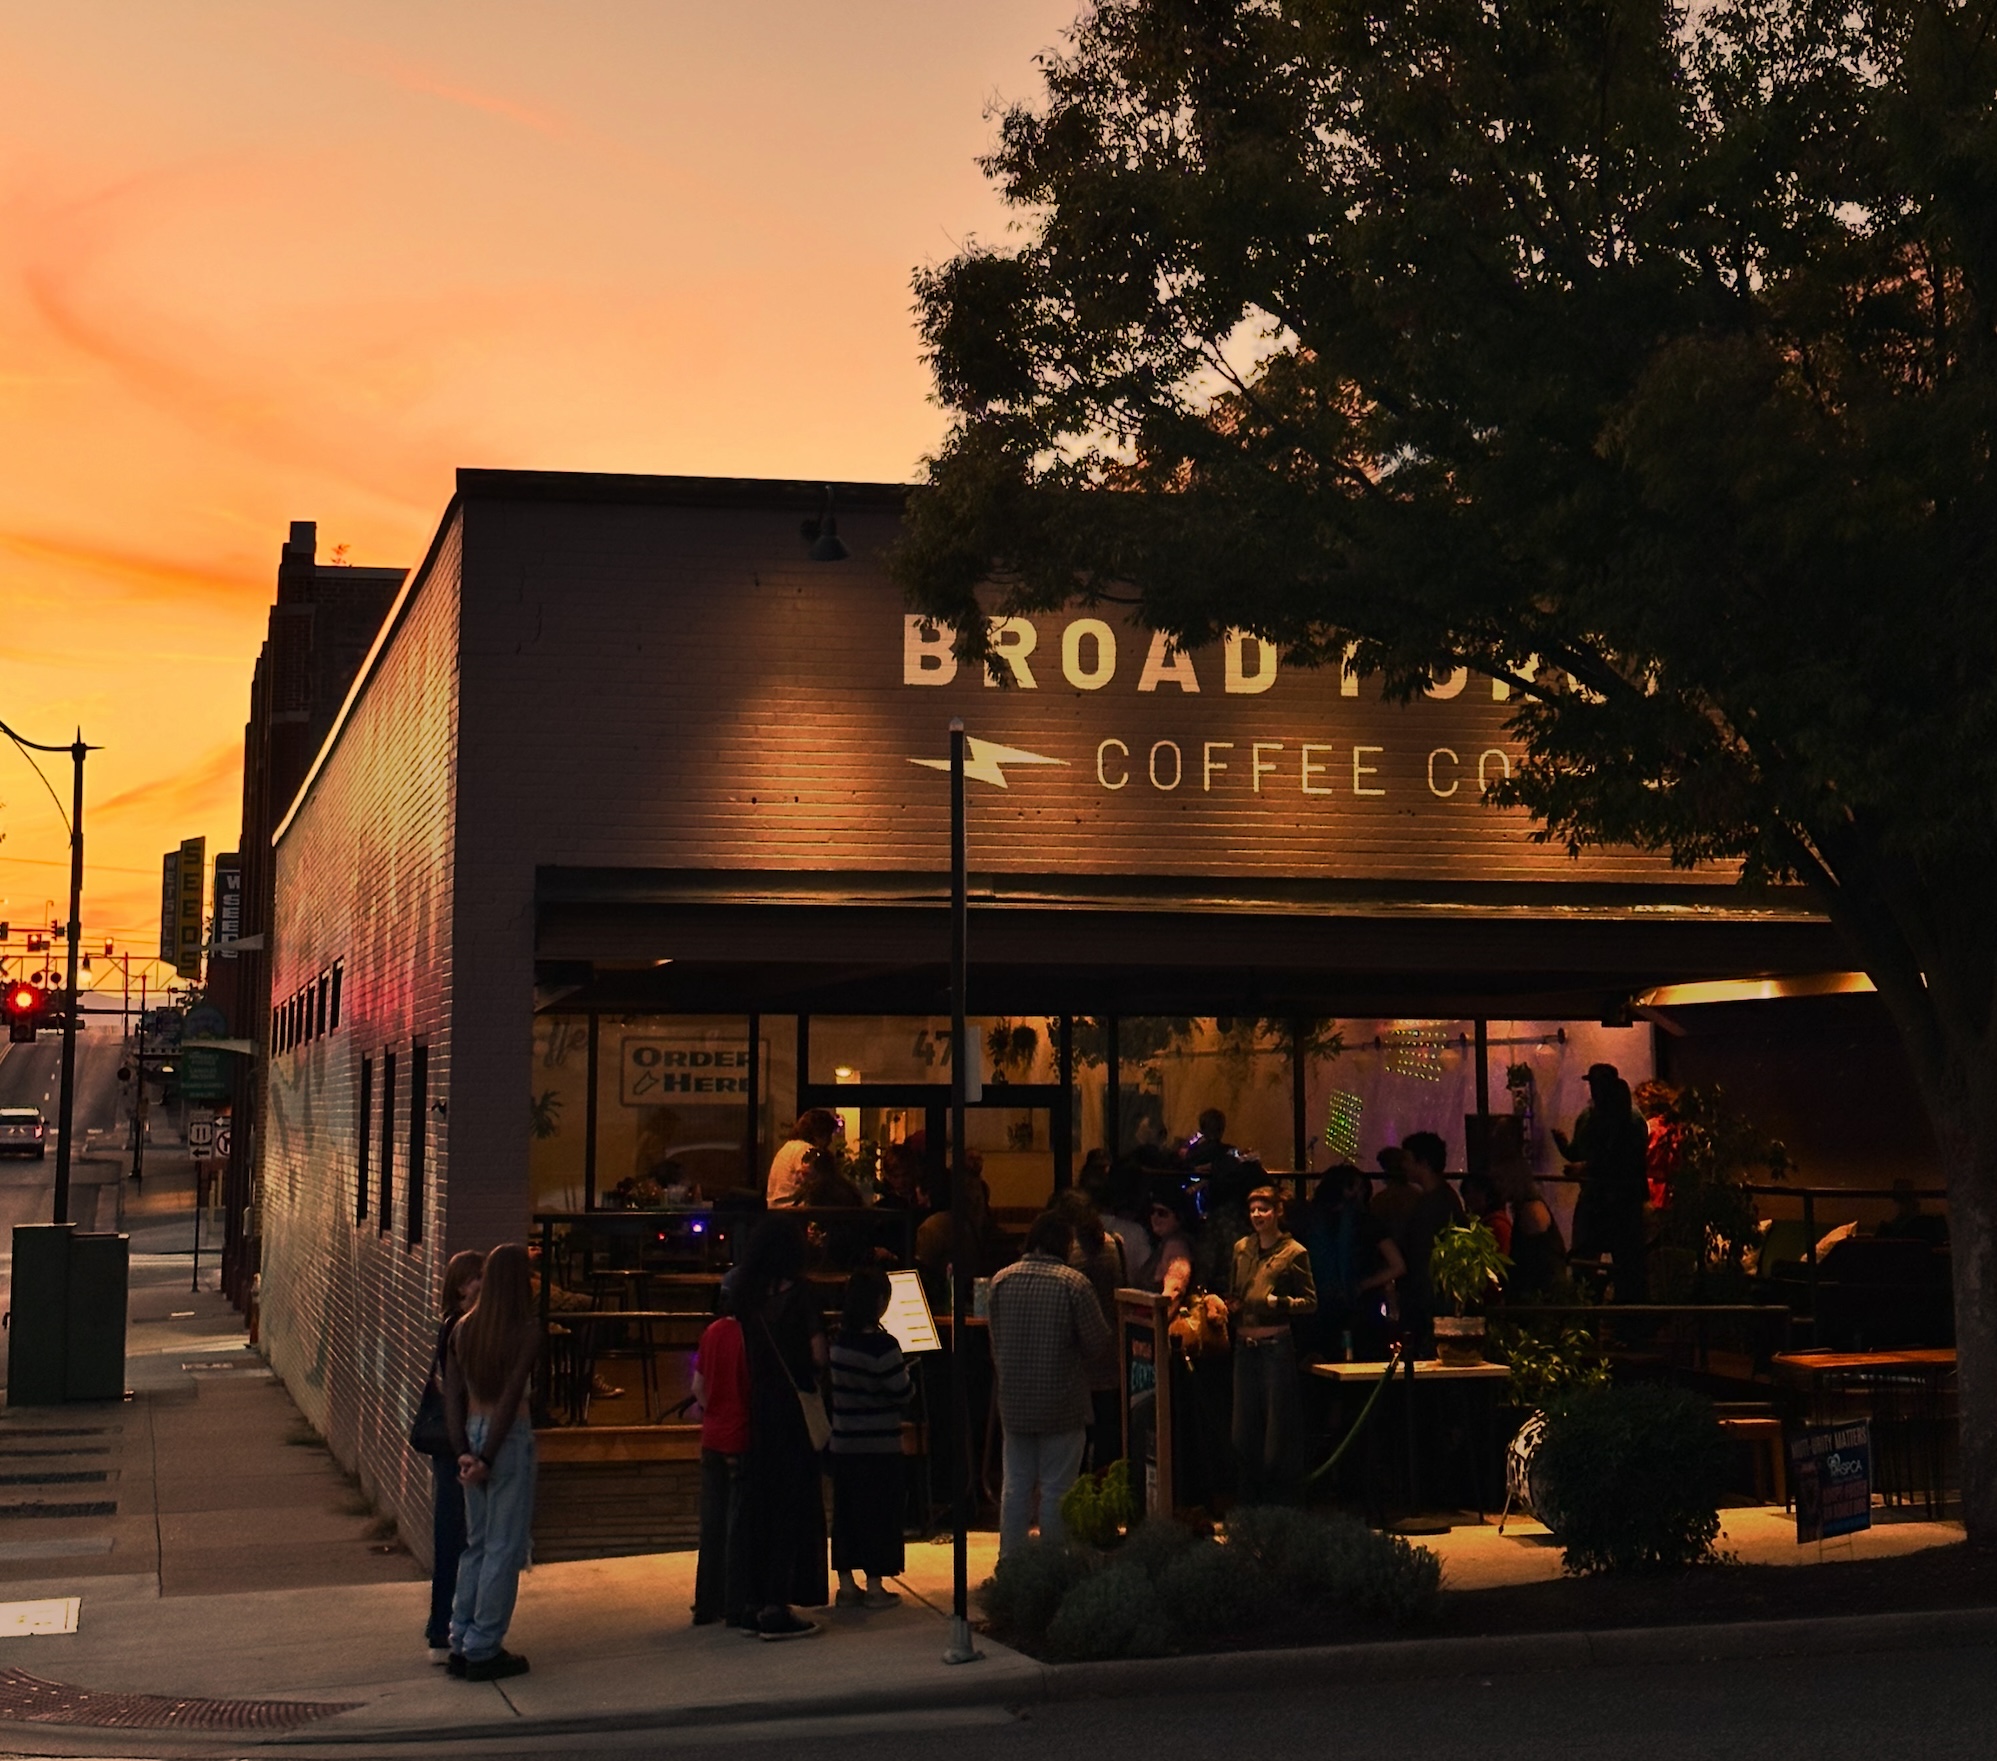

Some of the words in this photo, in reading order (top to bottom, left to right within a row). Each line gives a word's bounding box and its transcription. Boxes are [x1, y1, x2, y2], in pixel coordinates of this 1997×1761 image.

[904, 613, 1278, 694] BROAD
[1096, 738, 1387, 795] COFFEE
[181, 846, 200, 970] SEEDS
